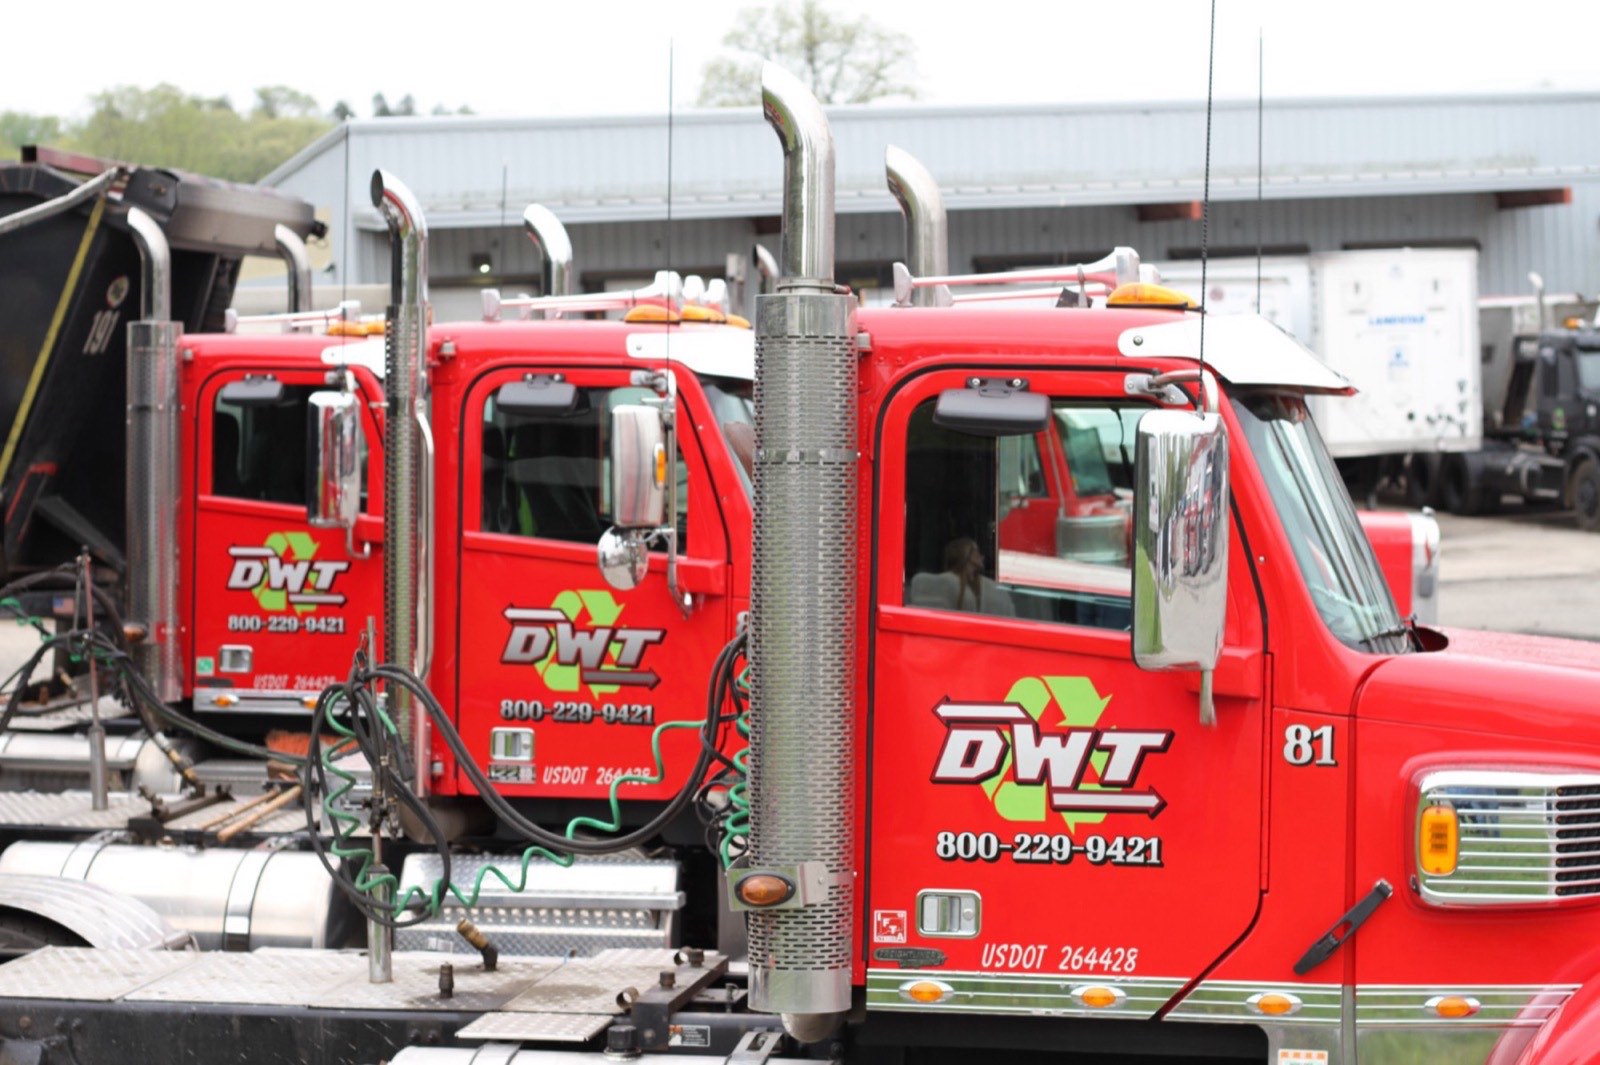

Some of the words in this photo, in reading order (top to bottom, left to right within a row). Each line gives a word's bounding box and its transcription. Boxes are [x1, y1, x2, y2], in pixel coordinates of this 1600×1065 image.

[82, 309, 121, 355] 191
[227, 554, 351, 595] DWT
[228, 614, 345, 634] 800-229-9421
[501, 617, 667, 673] DWT
[500, 699, 655, 725] 800-229-9421
[930, 716, 1174, 798] DWT
[1283, 724, 1338, 767] 81
[543, 766, 588, 785] USDOT
[936, 831, 1164, 867] 800-229-9421
[982, 943, 1048, 969] USDOT
[1058, 945, 1139, 972] 264428
